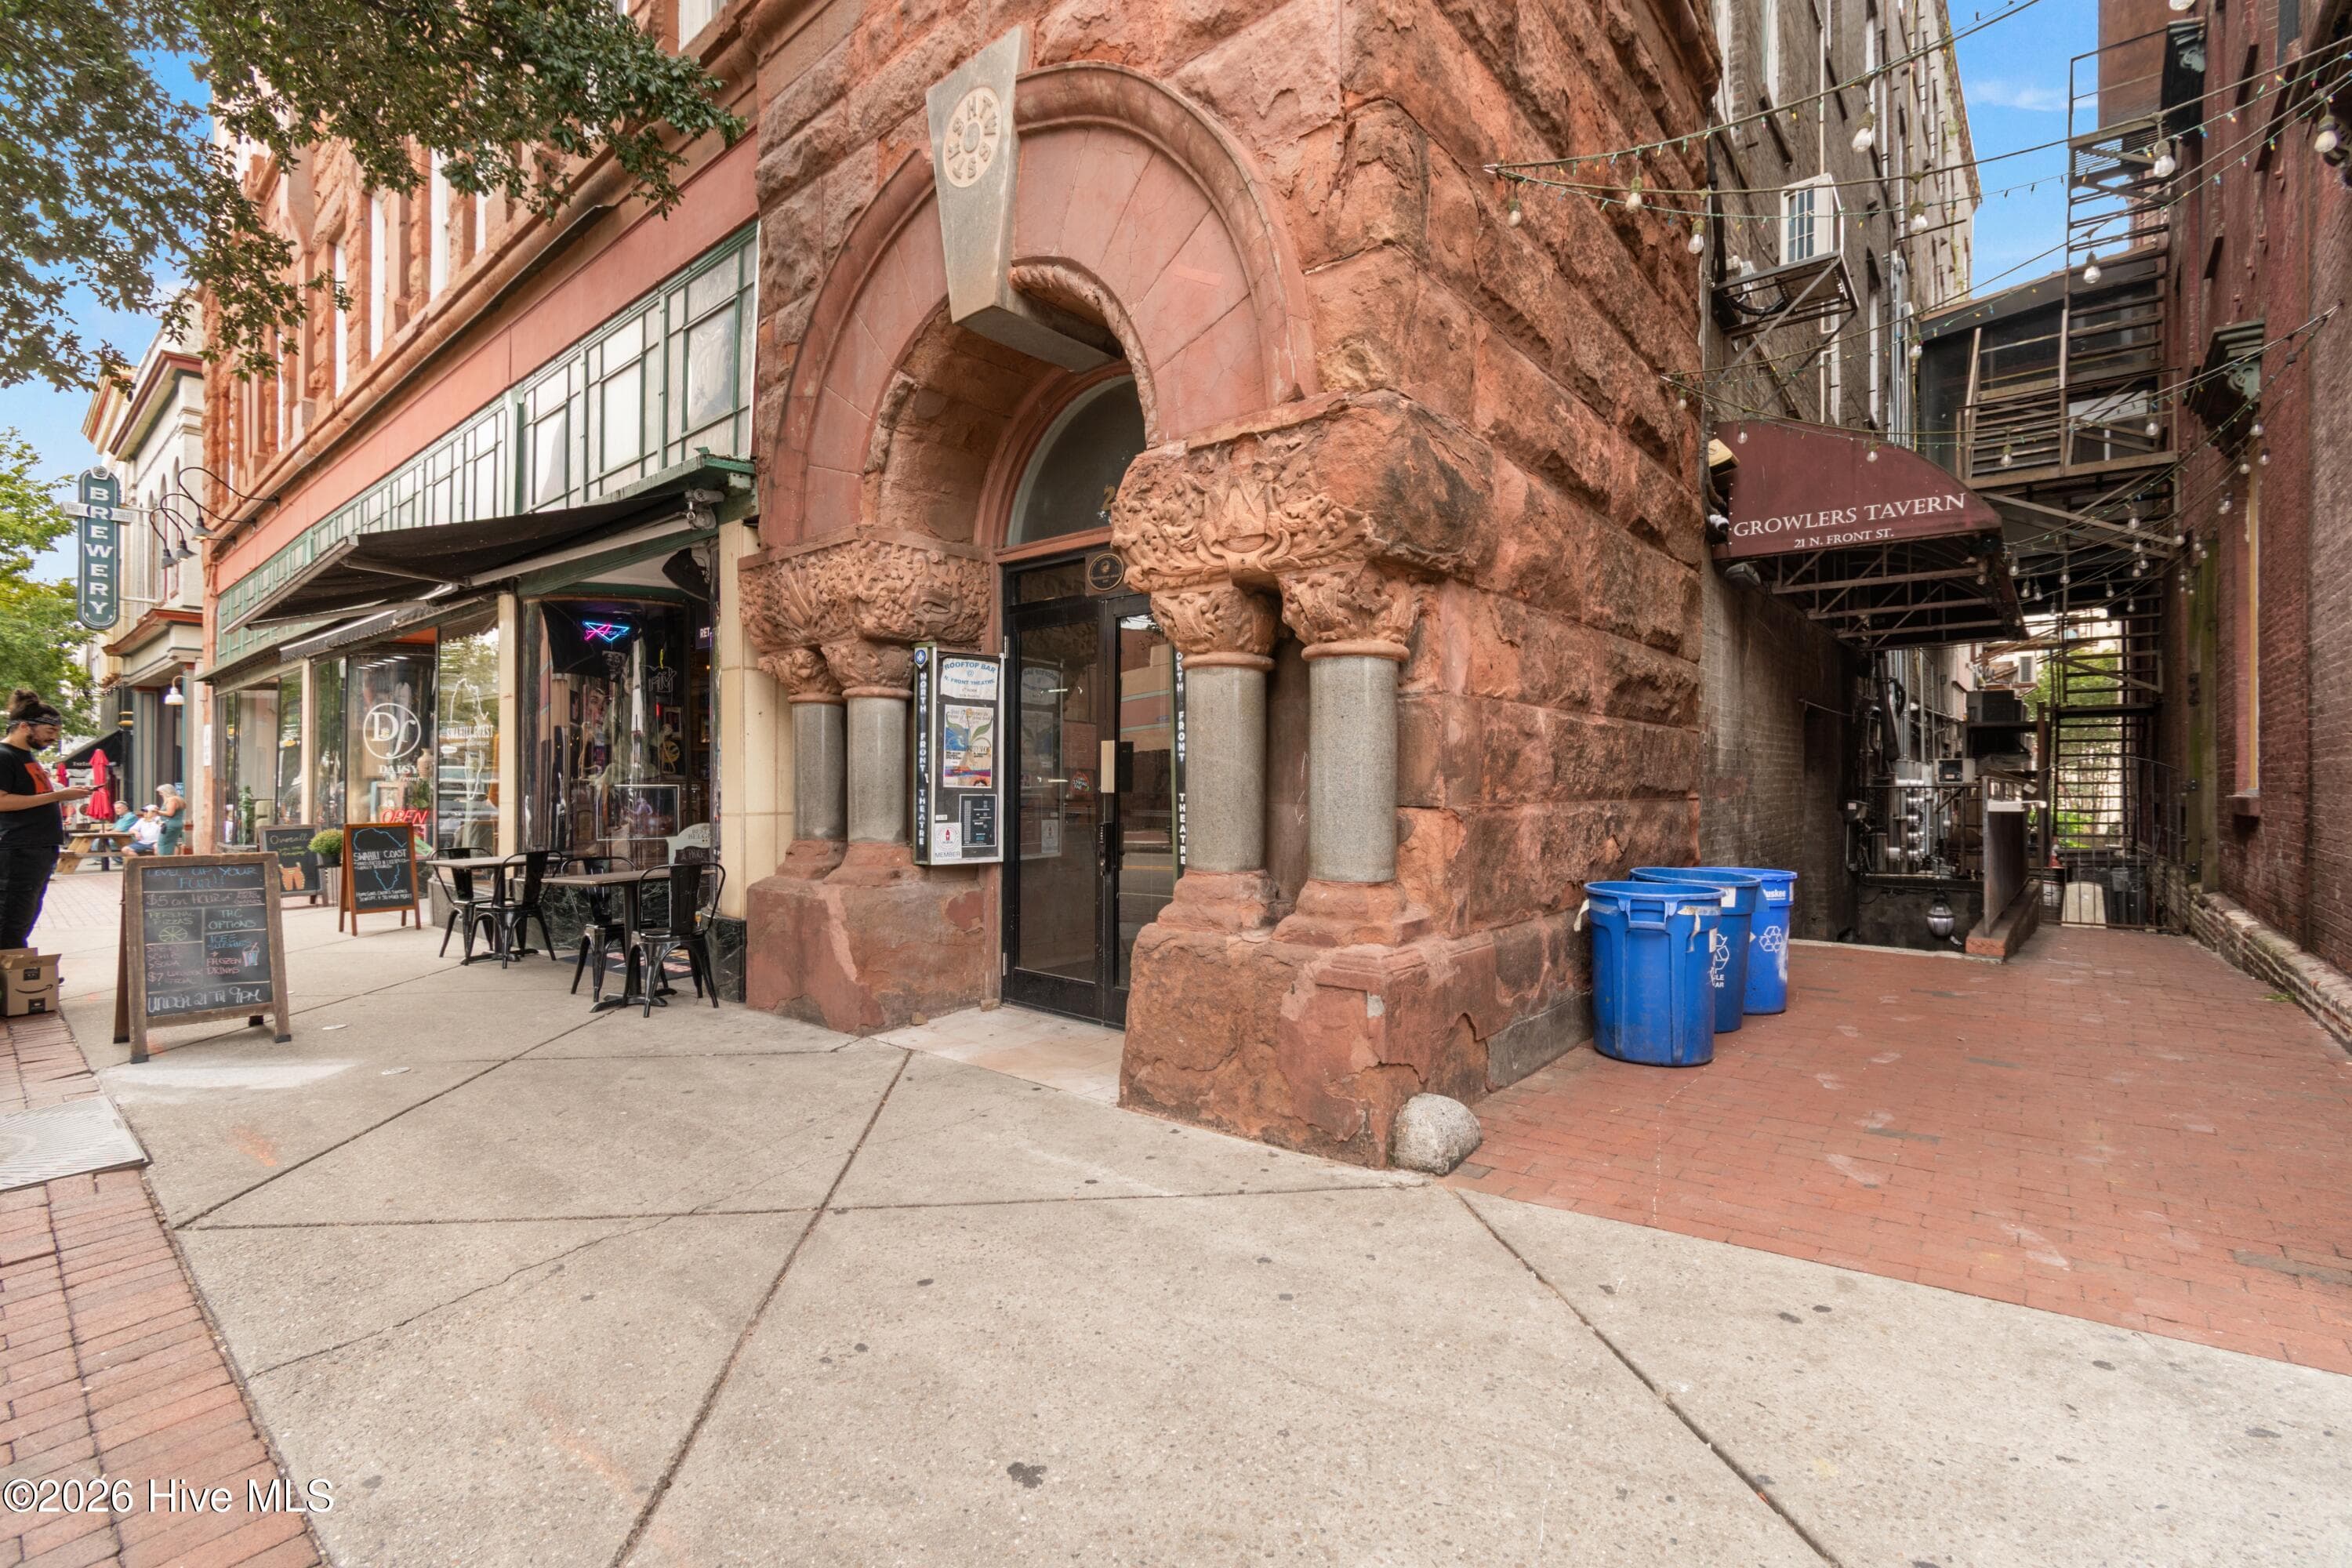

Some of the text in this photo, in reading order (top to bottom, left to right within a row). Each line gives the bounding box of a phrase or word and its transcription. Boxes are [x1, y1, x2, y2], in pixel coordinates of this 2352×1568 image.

[1733, 493, 1966, 537] GROWLERS TAVERN
[1794, 528, 1894, 548] 21 N. FRONT ST.
[85, 487, 114, 615] BREWERY
[944, 662, 996, 673] ROOFTOP BAR
[1175, 652, 1184, 691] ORTH
[379, 764, 419, 774] DAISY
[380, 808, 428, 824] OPEN
[1178, 793, 1186, 865] THEATRE
[353, 848, 407, 862] SWAHILI COAST
[146, 866, 258, 877] LEVEL UP YOUR
[191, 893, 220, 904] HOUR
[220, 909, 243, 918] THC
[208, 920, 257, 930] OPTIONS
[206, 957, 243, 967] FROZEN
[206, 966, 240, 975] DRINKS
[147, 993, 192, 1014] UNDER
[194, 992, 208, 1006] 21
[228, 985, 263, 1004] 9PM
